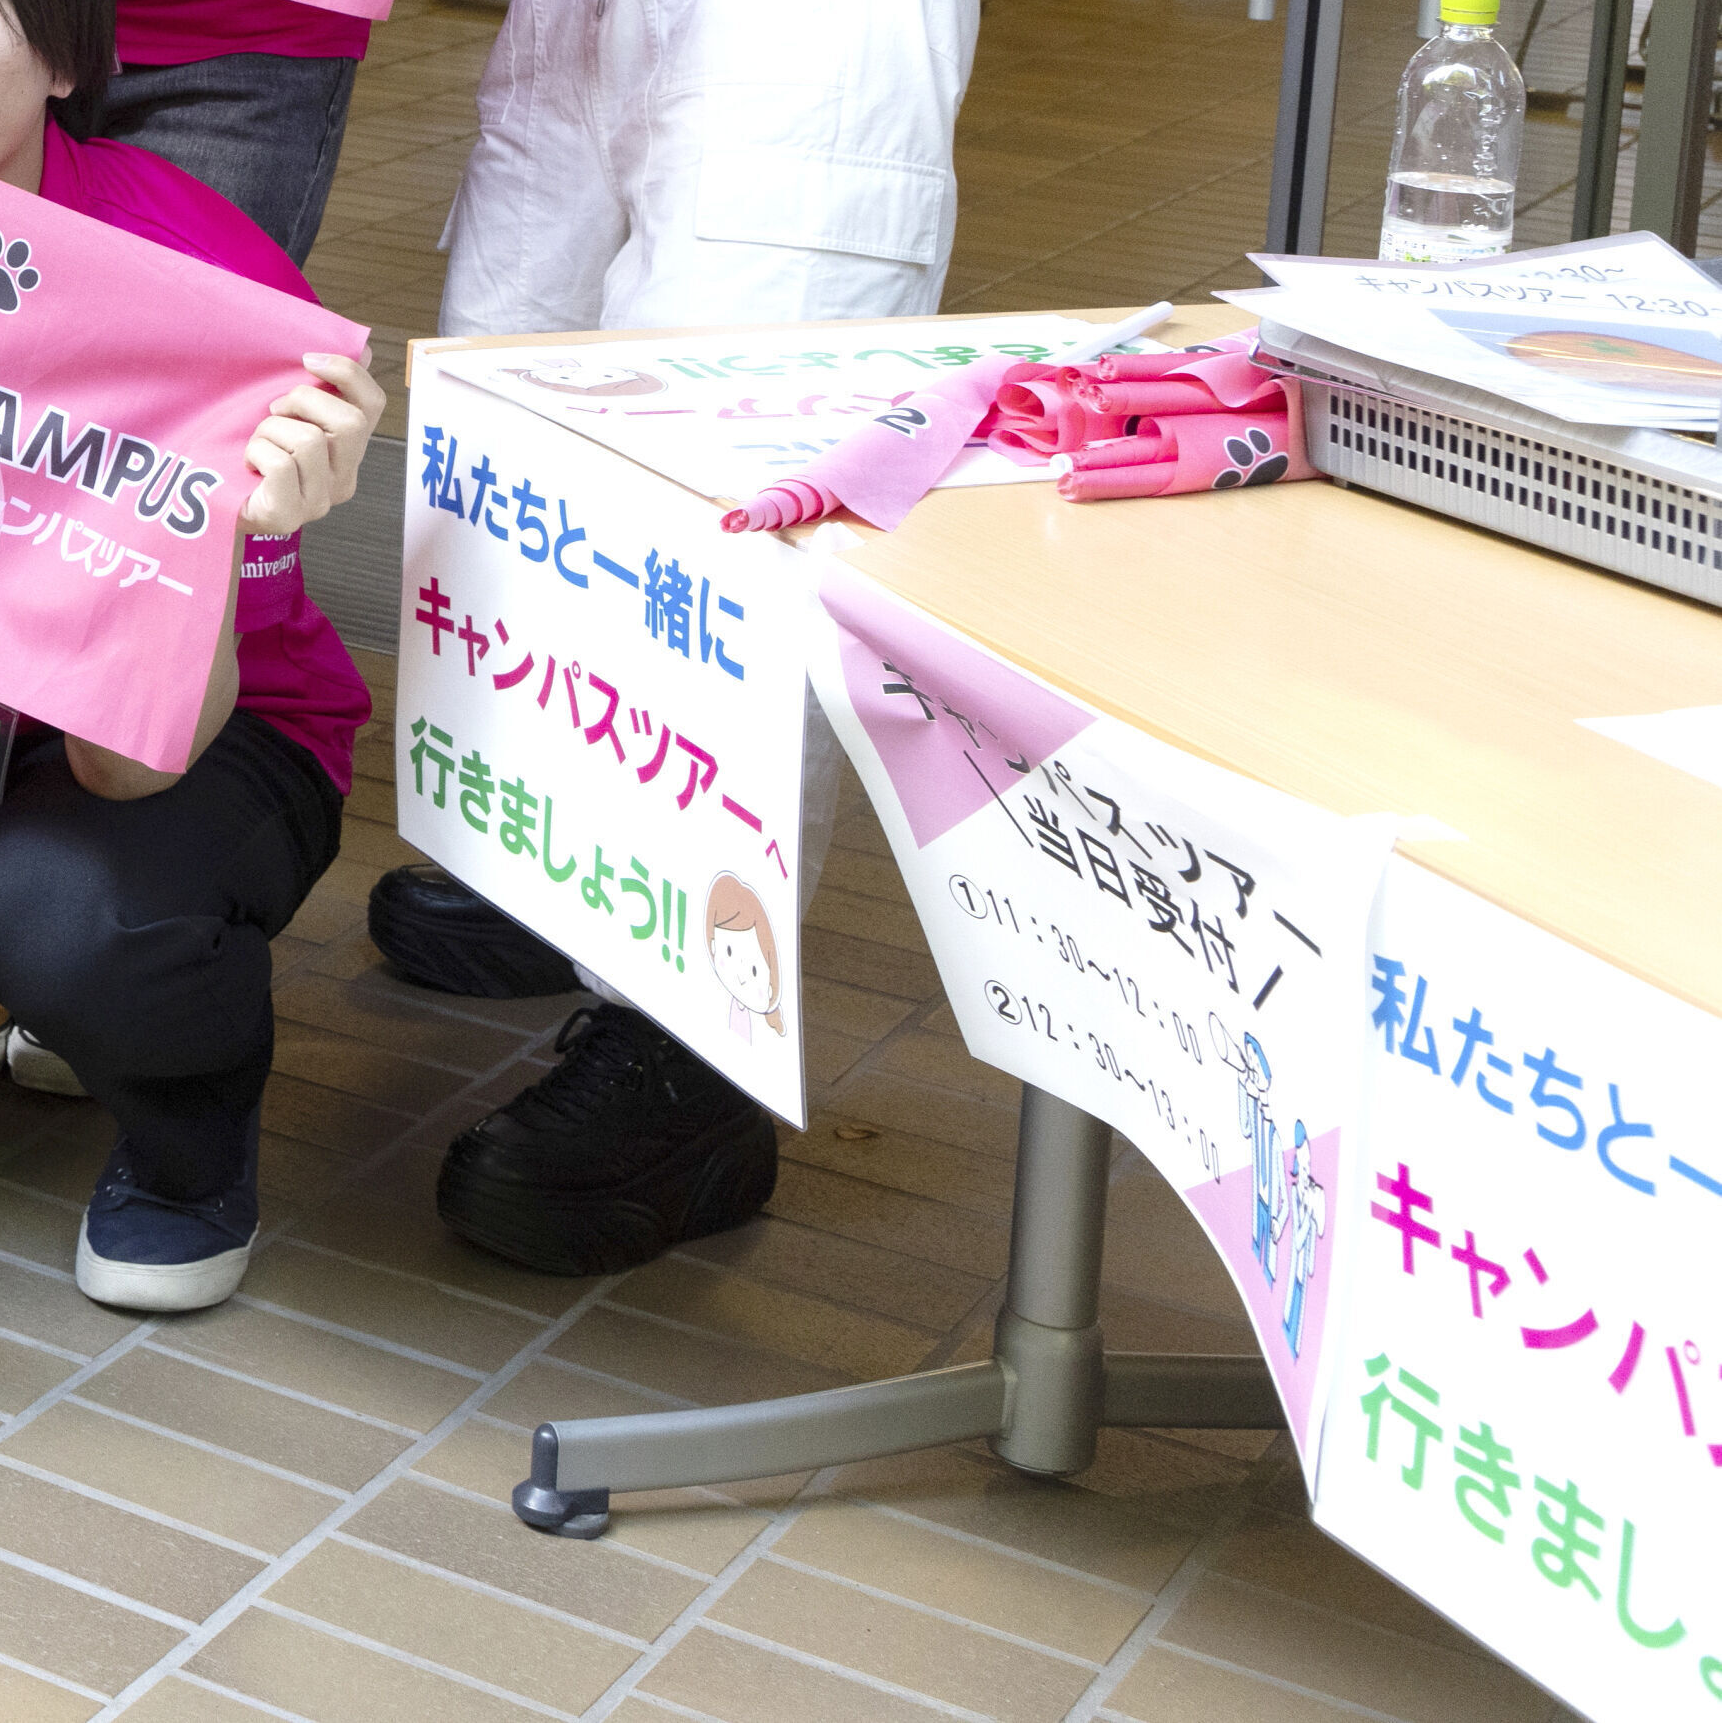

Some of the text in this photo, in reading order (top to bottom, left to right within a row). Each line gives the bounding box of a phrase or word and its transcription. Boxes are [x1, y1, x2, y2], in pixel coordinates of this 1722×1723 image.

[1357, 273, 1586, 303] キャンパスツアー
[422, 425, 746, 680] 私たちと一緒に
[410, 716, 688, 974] 行きましょう!!
[415, 576, 789, 880] キャンパスツアーへ
[1371, 953, 1722, 1197] 私たちと一
[1370, 1162, 1722, 1468] キャンパ
